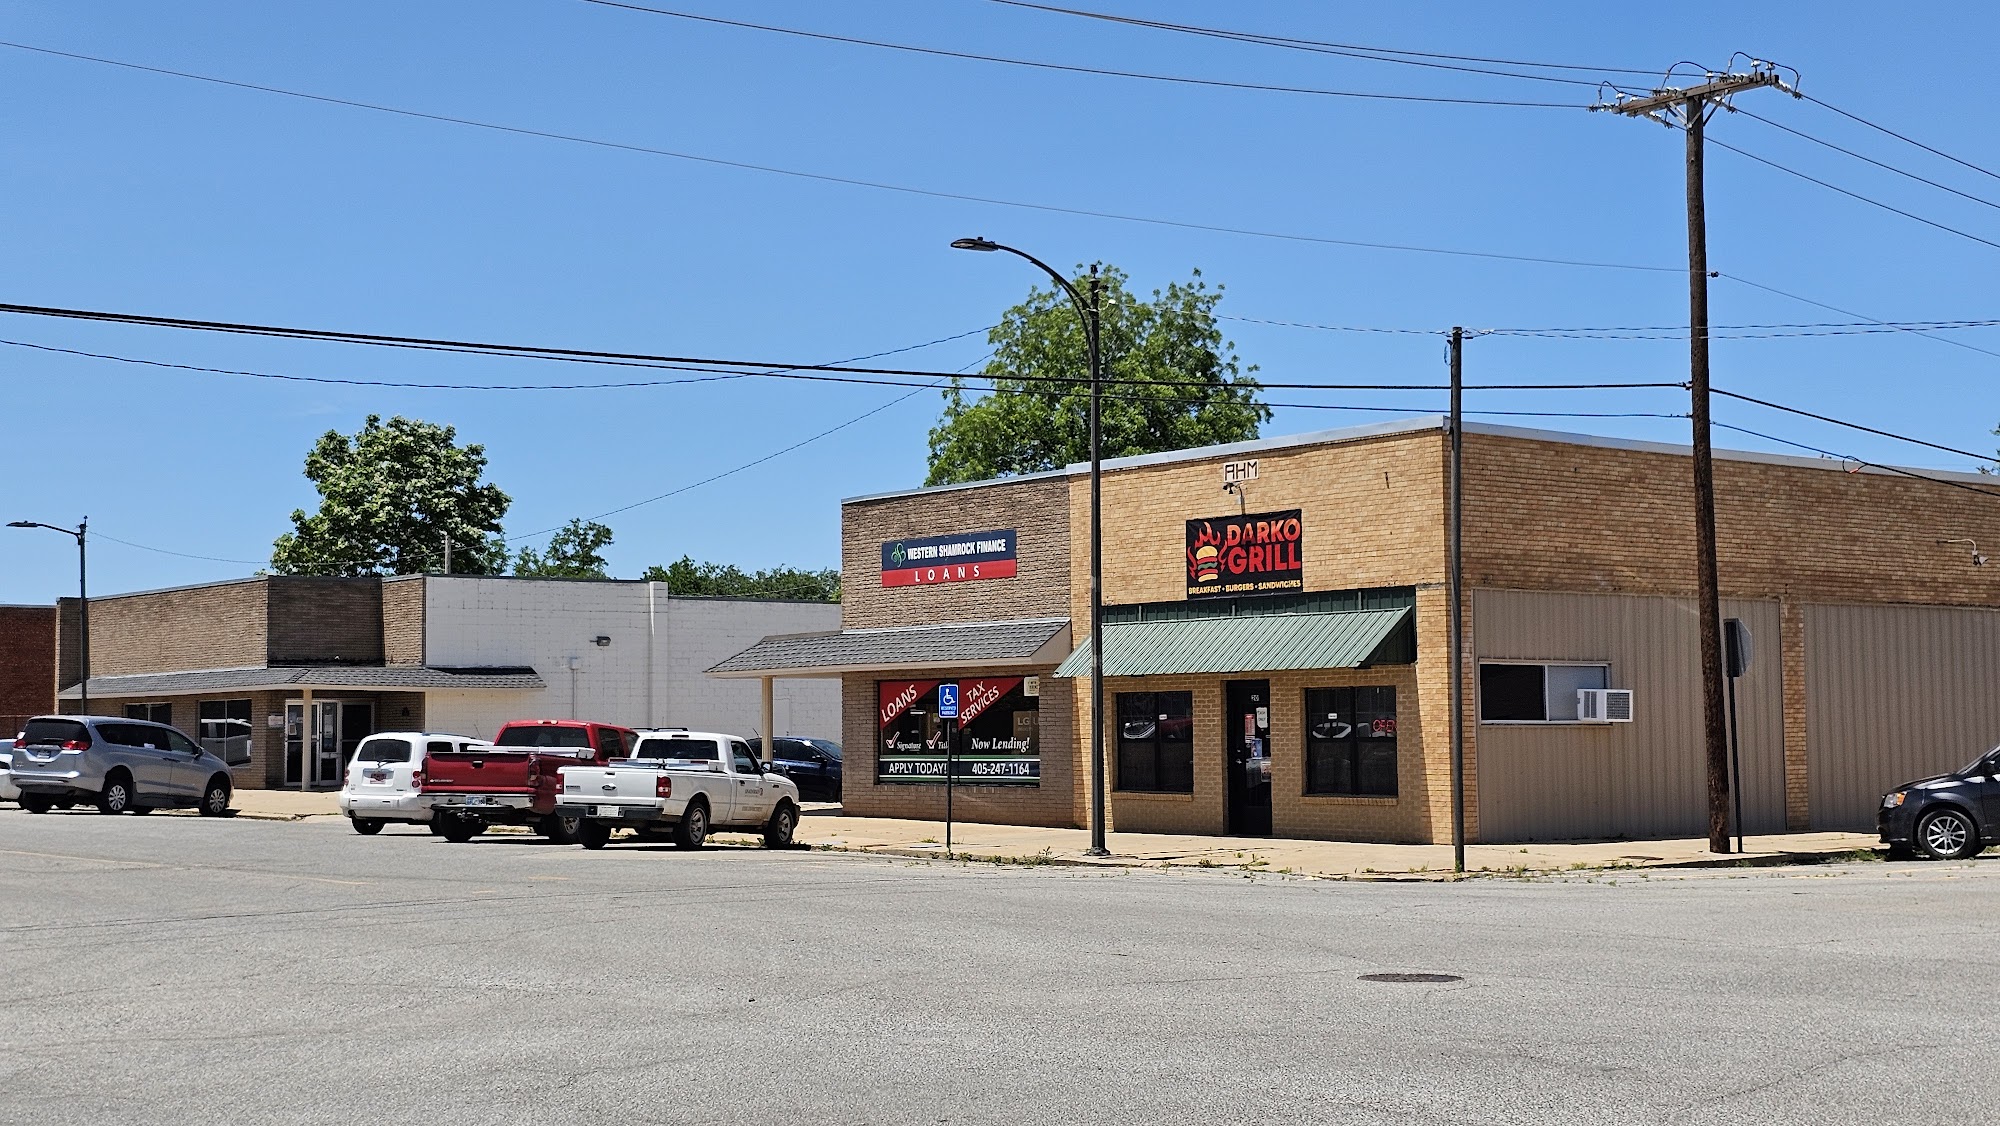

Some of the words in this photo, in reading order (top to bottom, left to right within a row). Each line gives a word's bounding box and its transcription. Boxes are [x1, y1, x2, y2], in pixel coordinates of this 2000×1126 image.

[1224, 461, 1258, 480] AHM
[1227, 518, 1301, 546] DARKO
[907, 547, 938, 560] WESTERN
[939, 541, 975, 557] SHAMROCK
[976, 539, 1007, 553] FINANCE
[1228, 543, 1301, 574] GRILL
[915, 565, 980, 582] LOANS
[1188, 585, 1222, 594] BREAKFAST
[1225, 583, 1254, 592] BURGERS
[1258, 580, 1301, 590] SANDWICHES
[966, 681, 986, 702] TAX
[881, 684, 917, 722] LOANS
[960, 686, 1000, 724] SERVICES
[896, 741, 921, 751] Signature
[938, 741, 949, 749] Titl
[971, 738, 990, 750] Now
[992, 737, 1030, 753] Lending!
[889, 762, 913, 774] APPLY
[915, 762, 948, 774] TODAY!
[971, 762, 1030, 775] 405-247-1164
